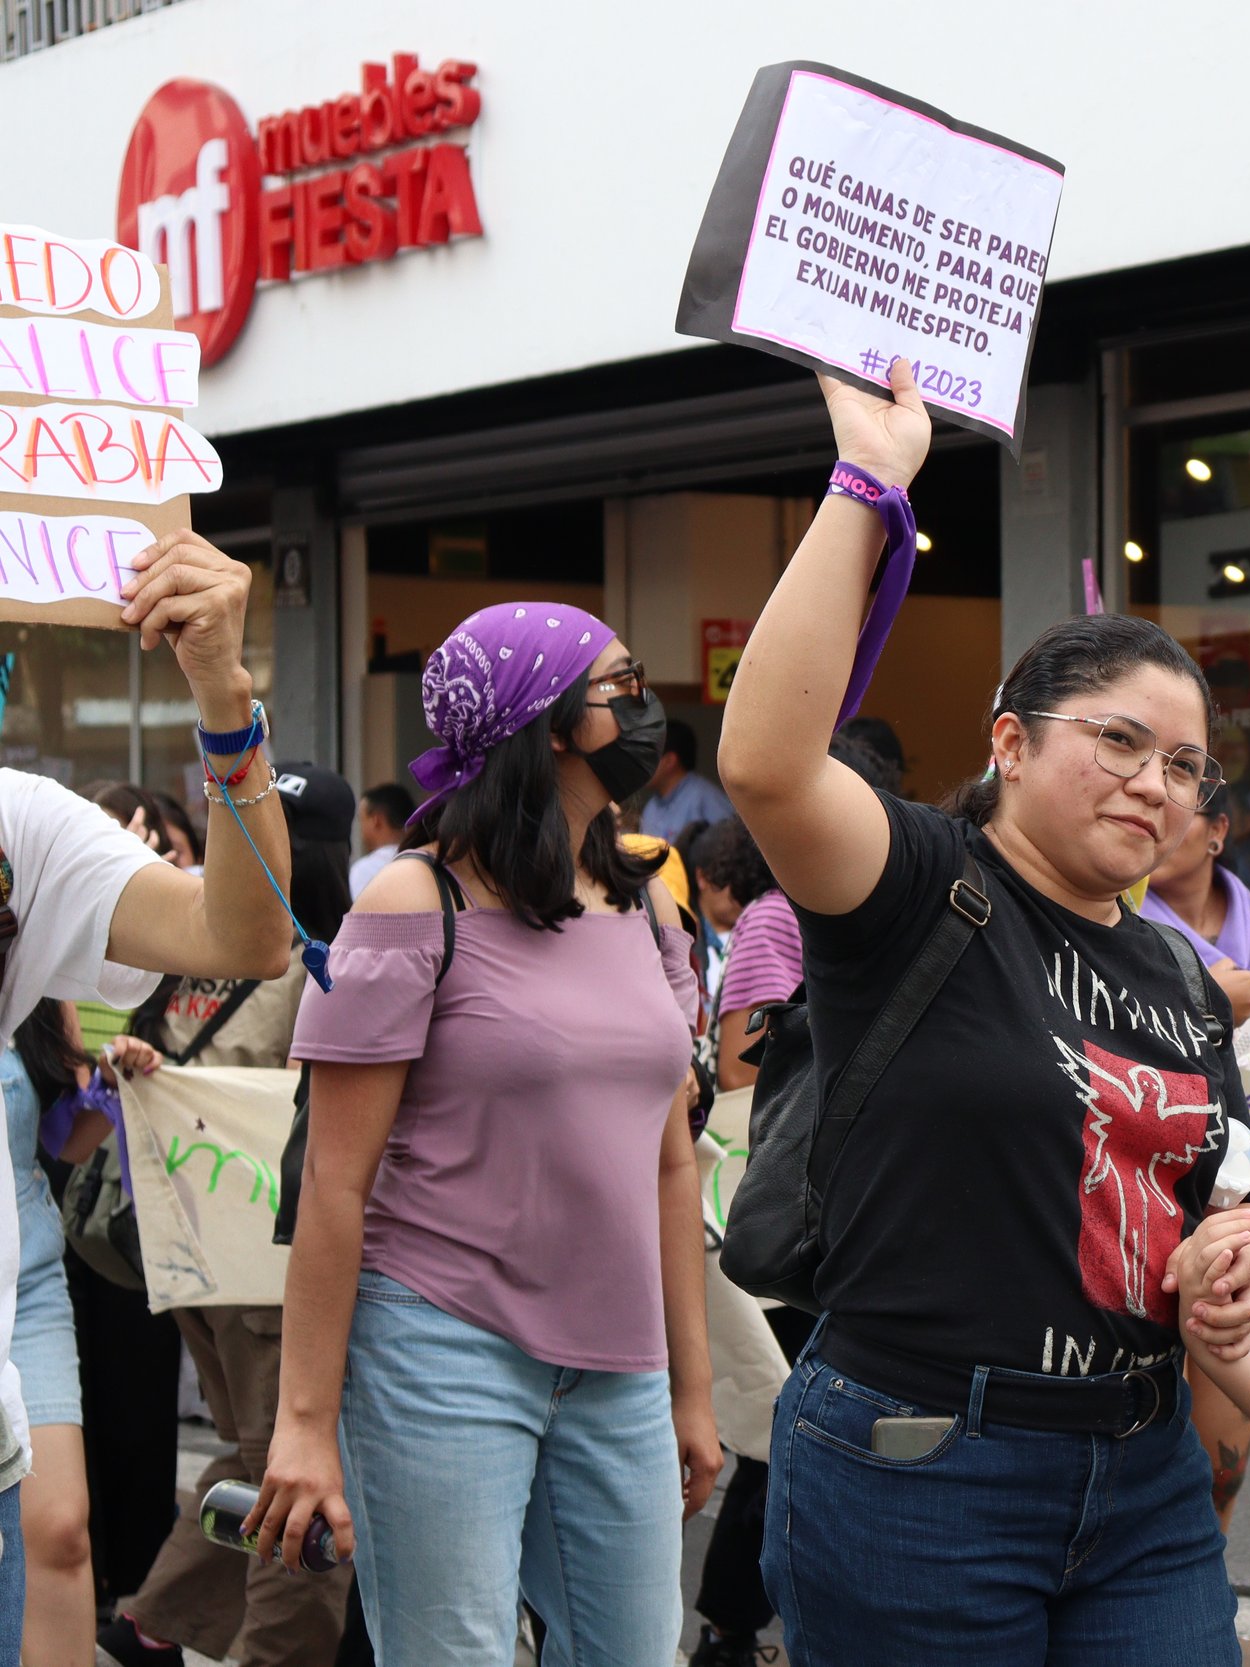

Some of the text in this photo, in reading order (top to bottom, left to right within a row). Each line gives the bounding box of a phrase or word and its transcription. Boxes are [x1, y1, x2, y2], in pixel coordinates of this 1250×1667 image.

[257, 51, 482, 178] muebles
[137, 137, 230, 320] mf
[257, 142, 485, 283] FIESTA
[781, 187, 1039, 307] O MONUMENTO, PARA QUE
[788, 156, 836, 189] QUÉ
[838, 174, 908, 220] GANAS
[912, 204, 936, 234] DE
[939, 218, 983, 250] SER
[3, 233, 142, 315] EDO
[765, 214, 789, 242] EL
[796, 226, 900, 284] GOBIERNO
[901, 269, 930, 300] ME
[933, 283, 1023, 334] PROTEJA
[796, 259, 868, 308] EXIJAN
[869, 291, 893, 319] MI
[896, 302, 992, 356] RESPETO.
[1041, 1326, 1096, 1376] IN
